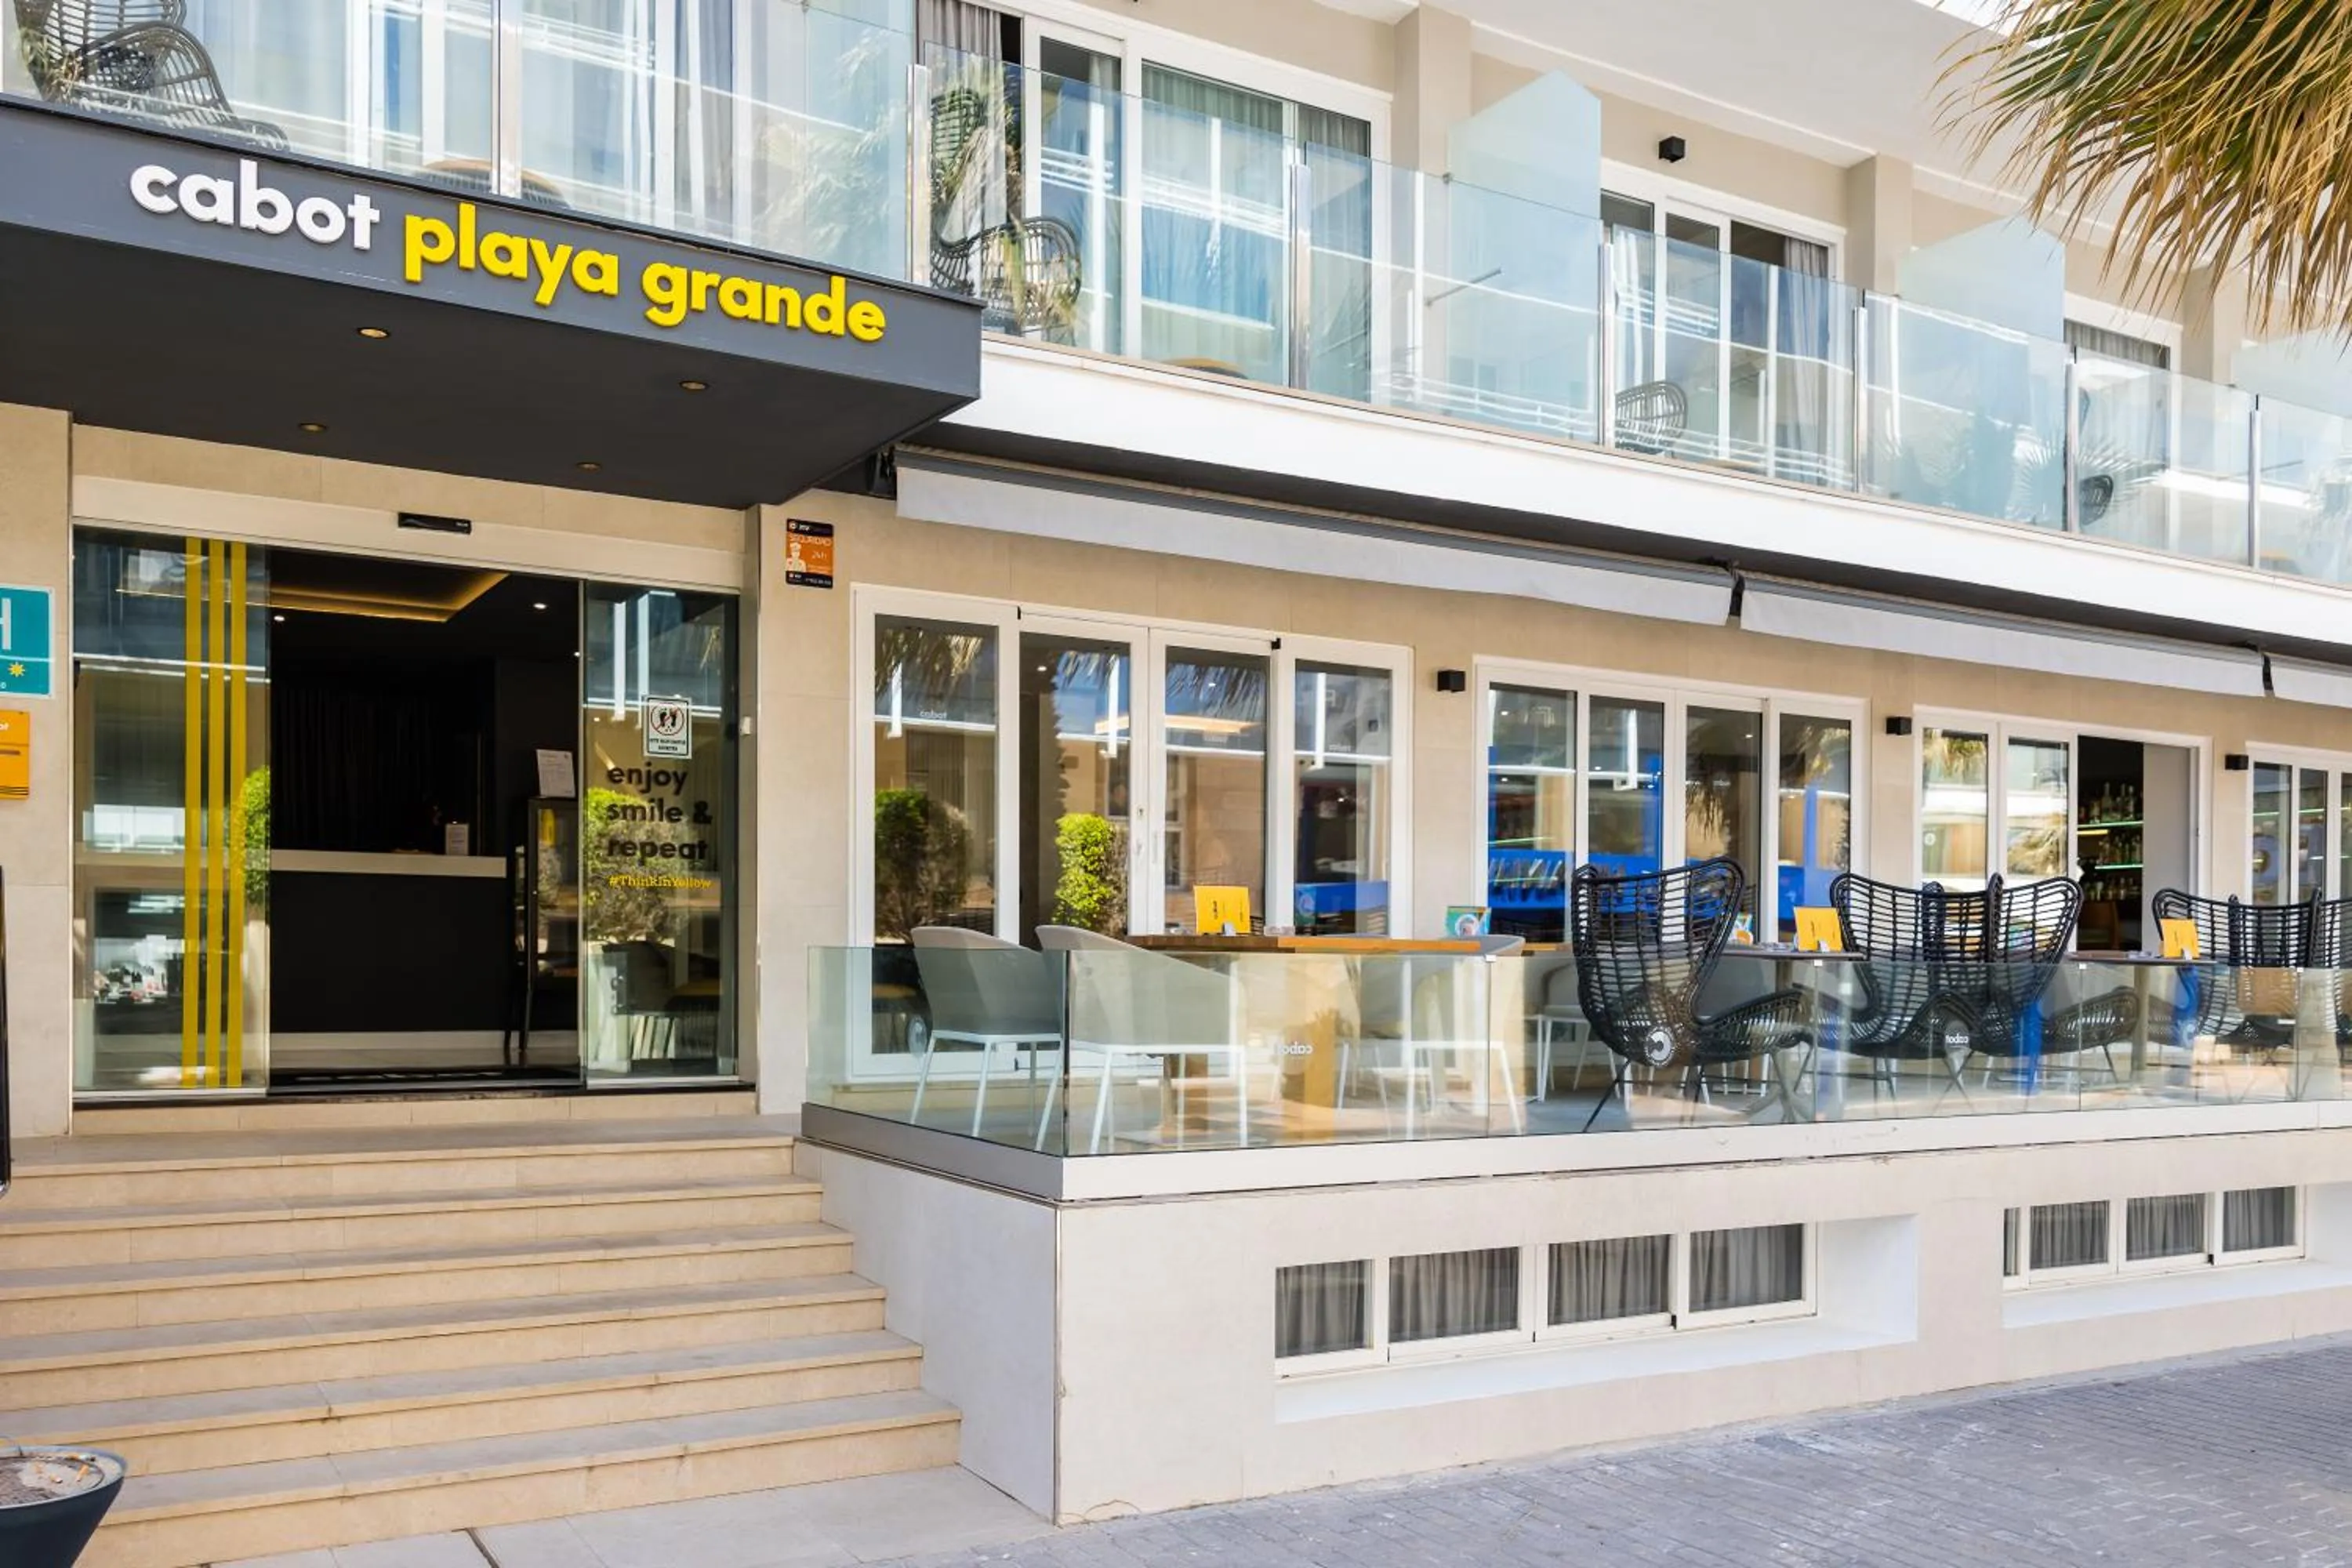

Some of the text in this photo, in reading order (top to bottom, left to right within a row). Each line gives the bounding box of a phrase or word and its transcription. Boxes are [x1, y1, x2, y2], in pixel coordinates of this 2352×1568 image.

[129, 159, 887, 343] cabot playa grande
[607, 762, 688, 795] enjoy
[607, 798, 712, 824] smile &
[608, 839, 709, 866] repeat
